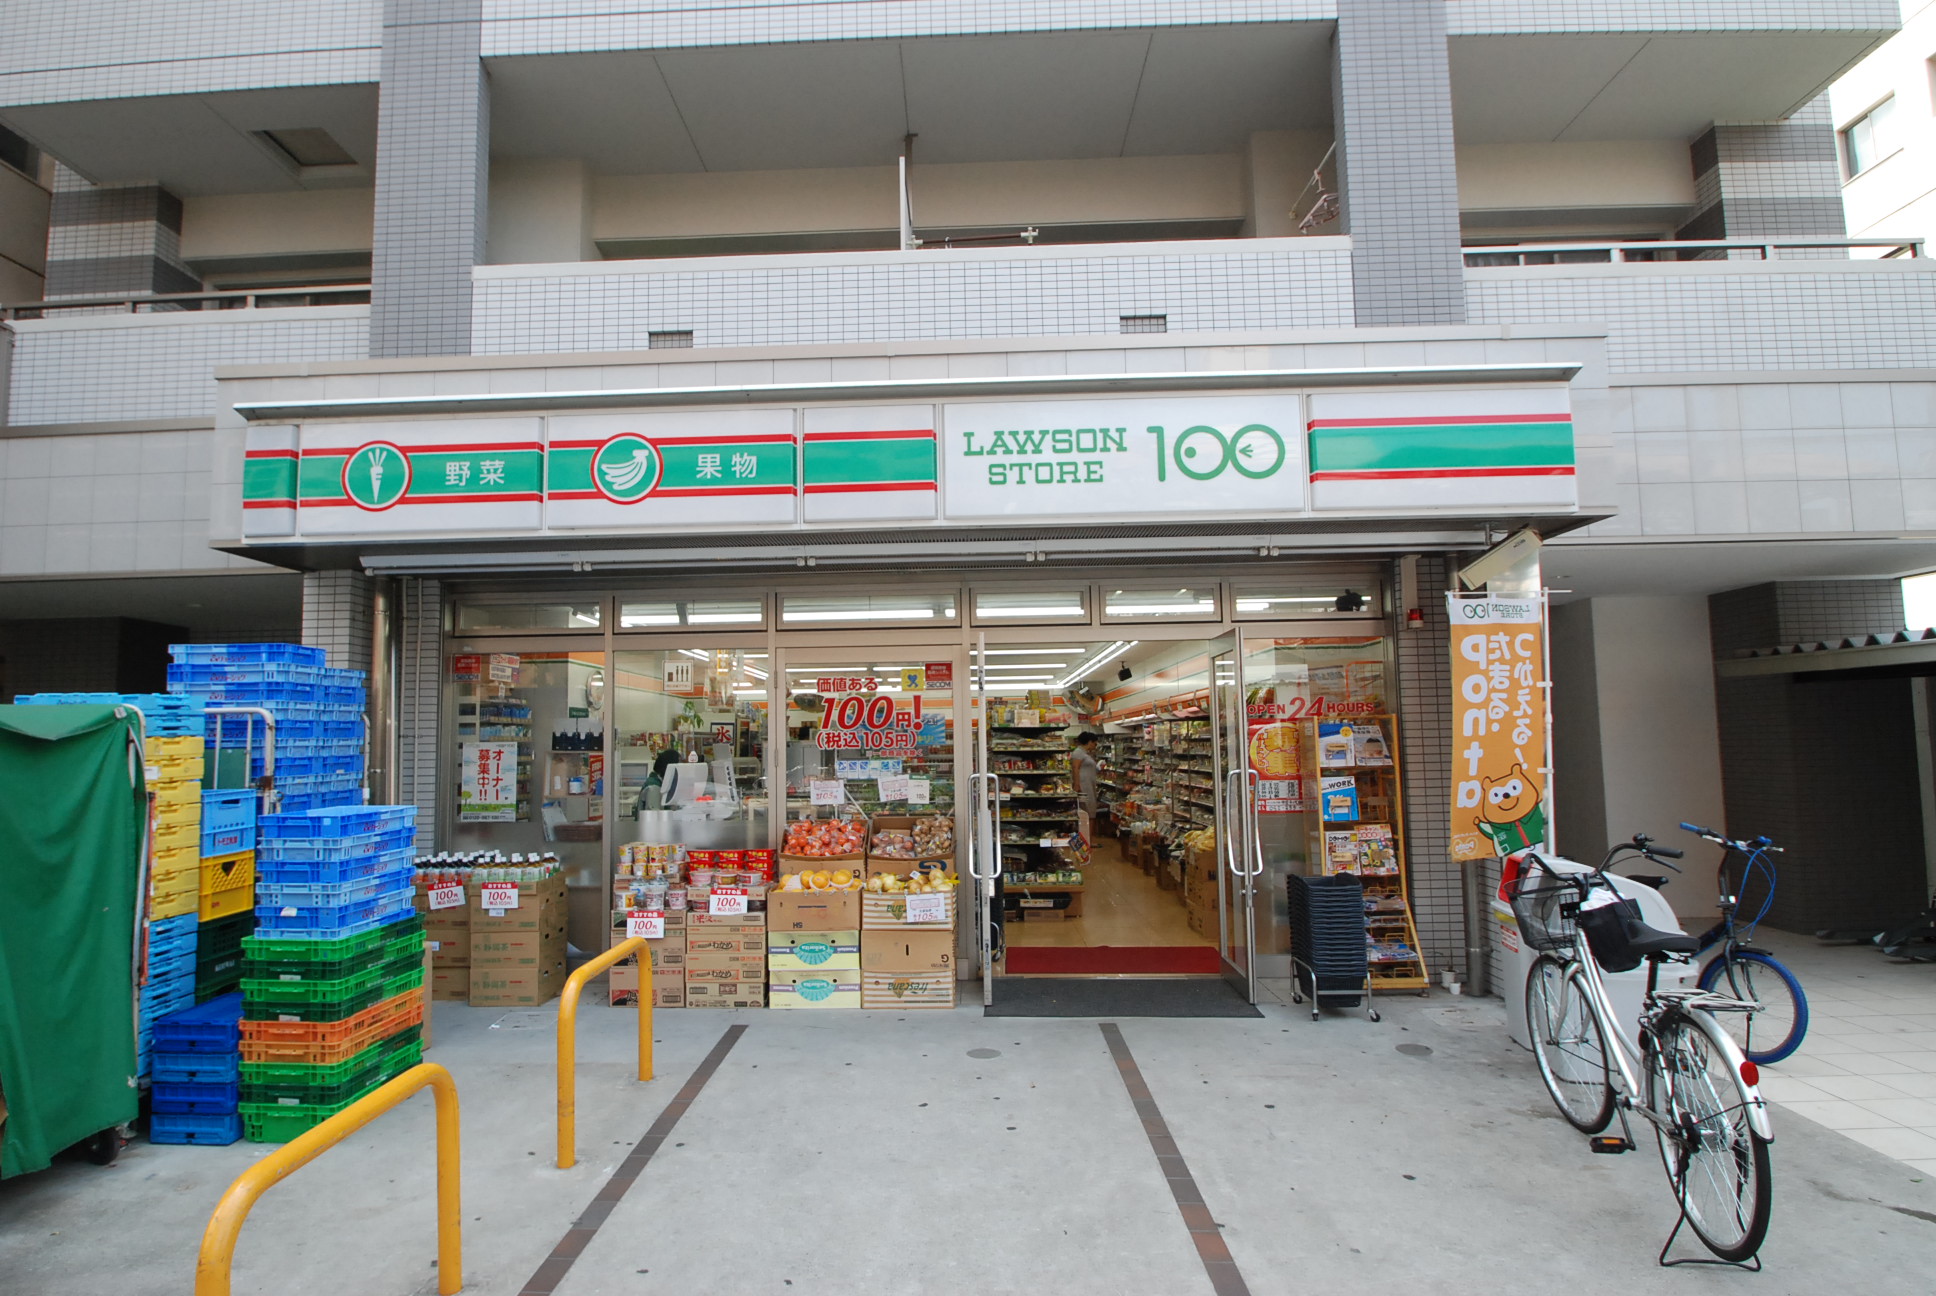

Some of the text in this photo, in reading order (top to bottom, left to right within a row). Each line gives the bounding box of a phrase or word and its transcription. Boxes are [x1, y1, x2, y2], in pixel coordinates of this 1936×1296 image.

[963, 427, 1128, 457] LAWSON
[1147, 423, 1286, 482] 100
[445, 459, 505, 486] 野菜
[695, 452, 758, 479] 果物
[988, 460, 1104, 486] STORE
[816, 677, 879, 693] 価値ある
[1246, 696, 1376, 720] OPEN 24 HOURS
[716, 725, 732, 743] 氷
[492, 748, 505, 801] オーナー
[1328, 779, 1354, 790] WORK
